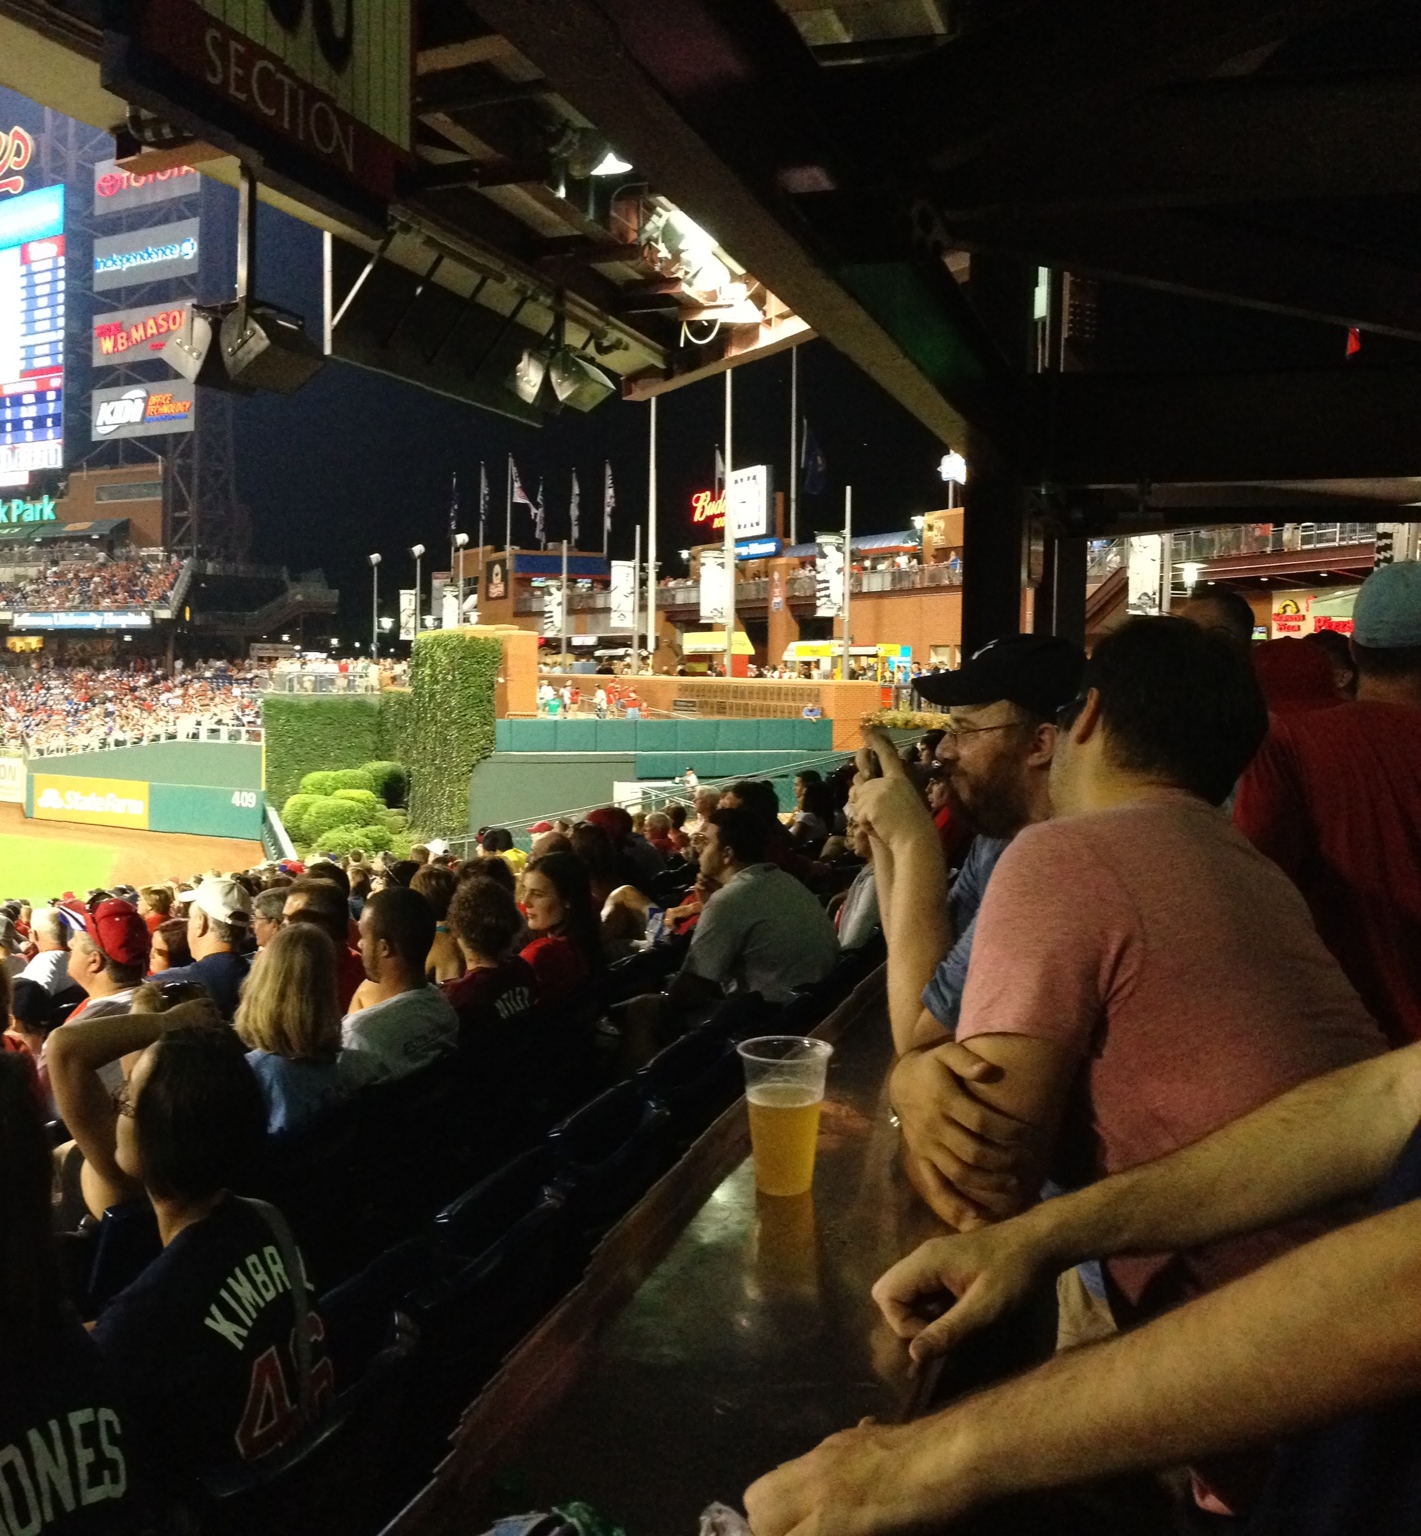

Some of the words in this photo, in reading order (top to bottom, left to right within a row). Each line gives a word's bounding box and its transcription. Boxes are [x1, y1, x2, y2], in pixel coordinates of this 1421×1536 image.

[204, 27, 354, 173] SECTION
[94, 245, 180, 273] Independence
[11, 494, 57, 523] Park
[231, 791, 257, 809] 409
[202, 1244, 316, 1352] KIMBRL
